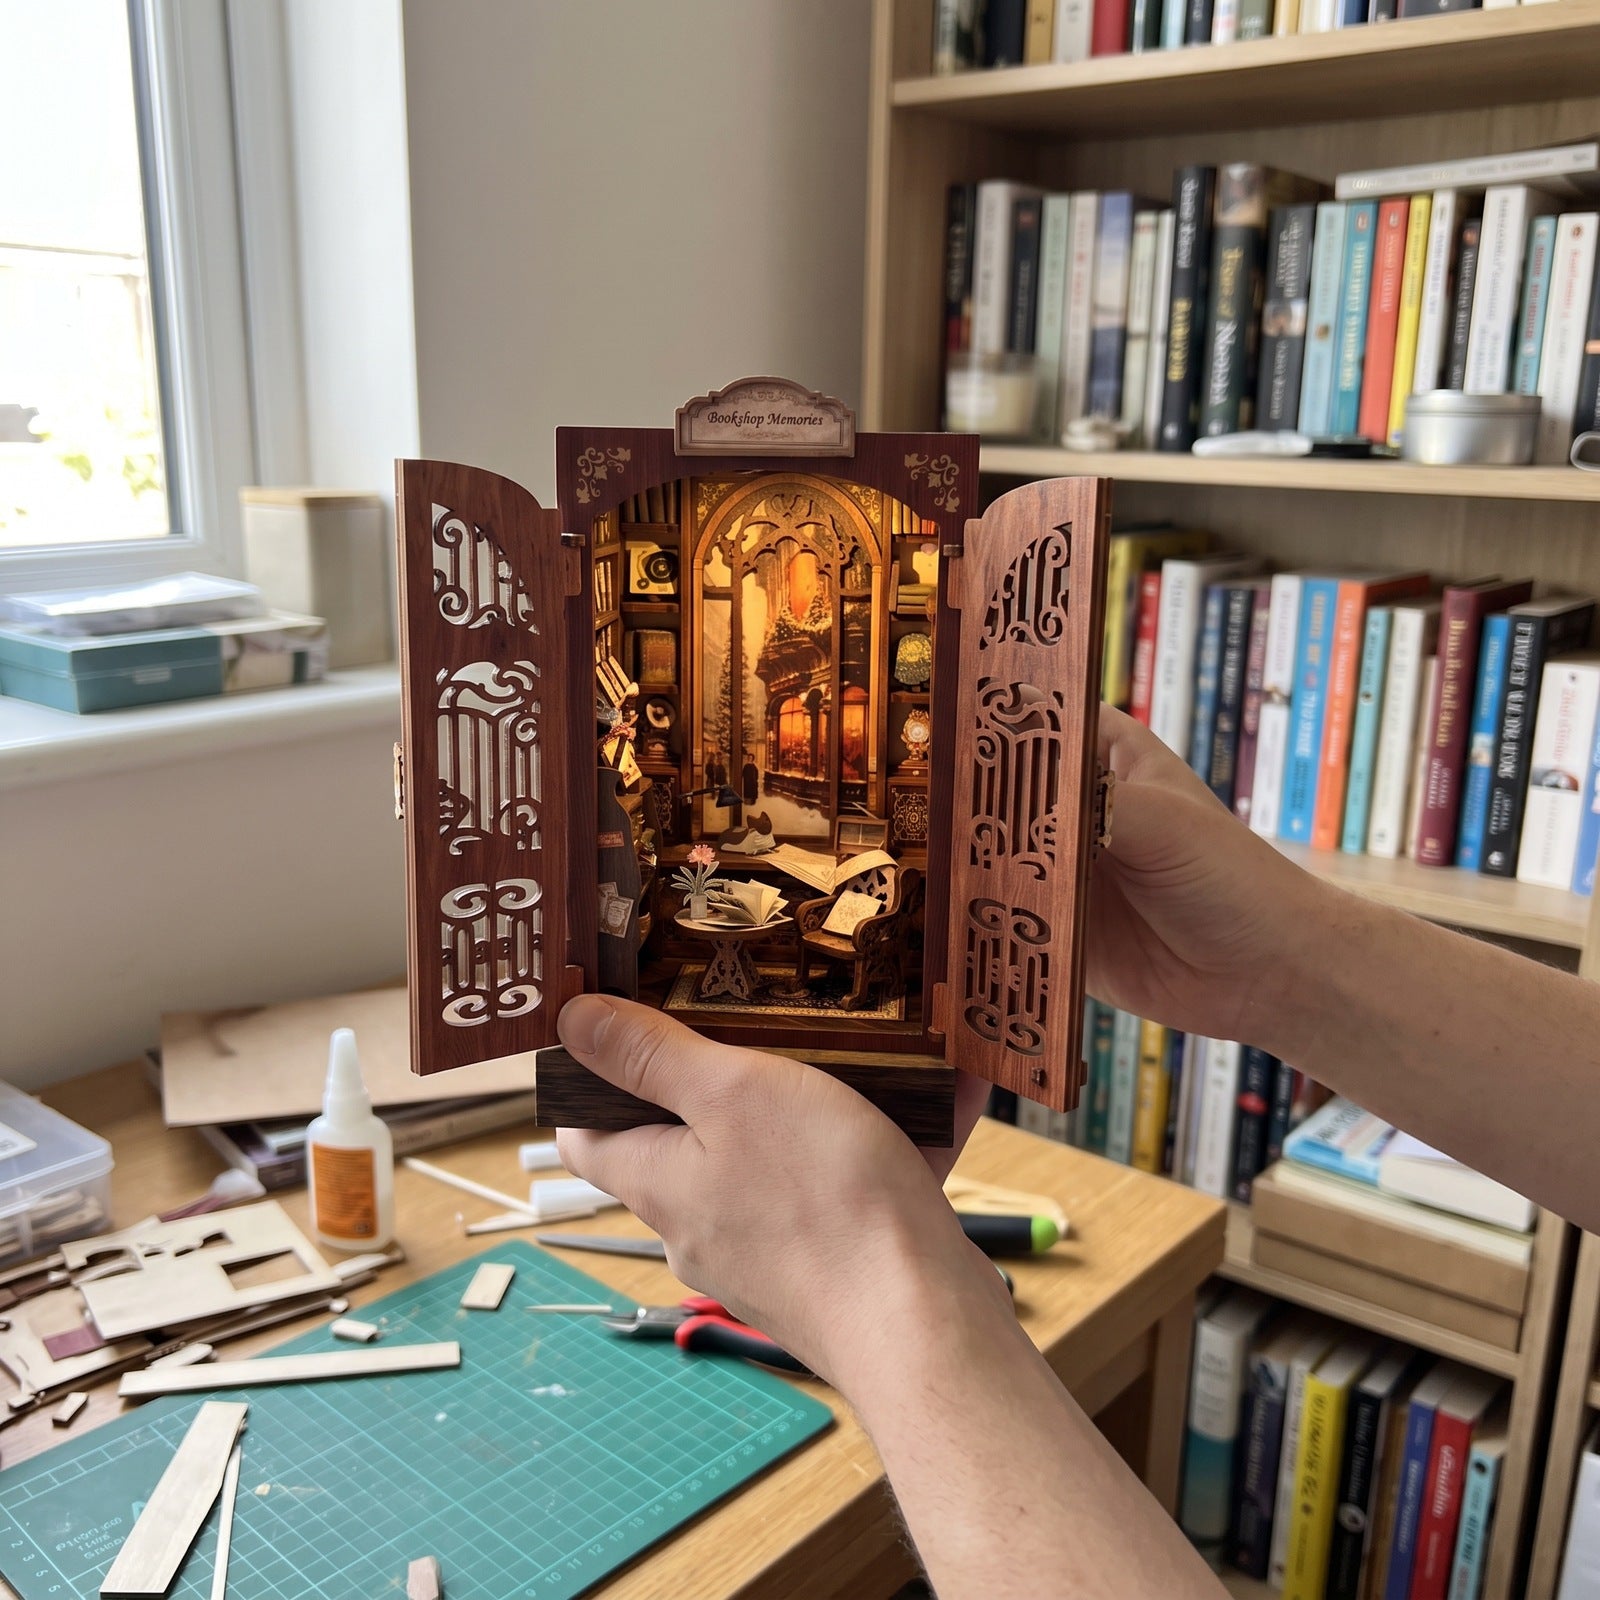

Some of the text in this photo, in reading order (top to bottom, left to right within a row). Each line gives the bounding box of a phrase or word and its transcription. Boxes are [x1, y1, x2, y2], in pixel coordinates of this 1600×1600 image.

[707, 411, 823, 428] Bookshop Memories
[545, 1571, 562, 1584] 10
[567, 1558, 583, 1570] 11
[588, 1543, 604, 1556] 12
